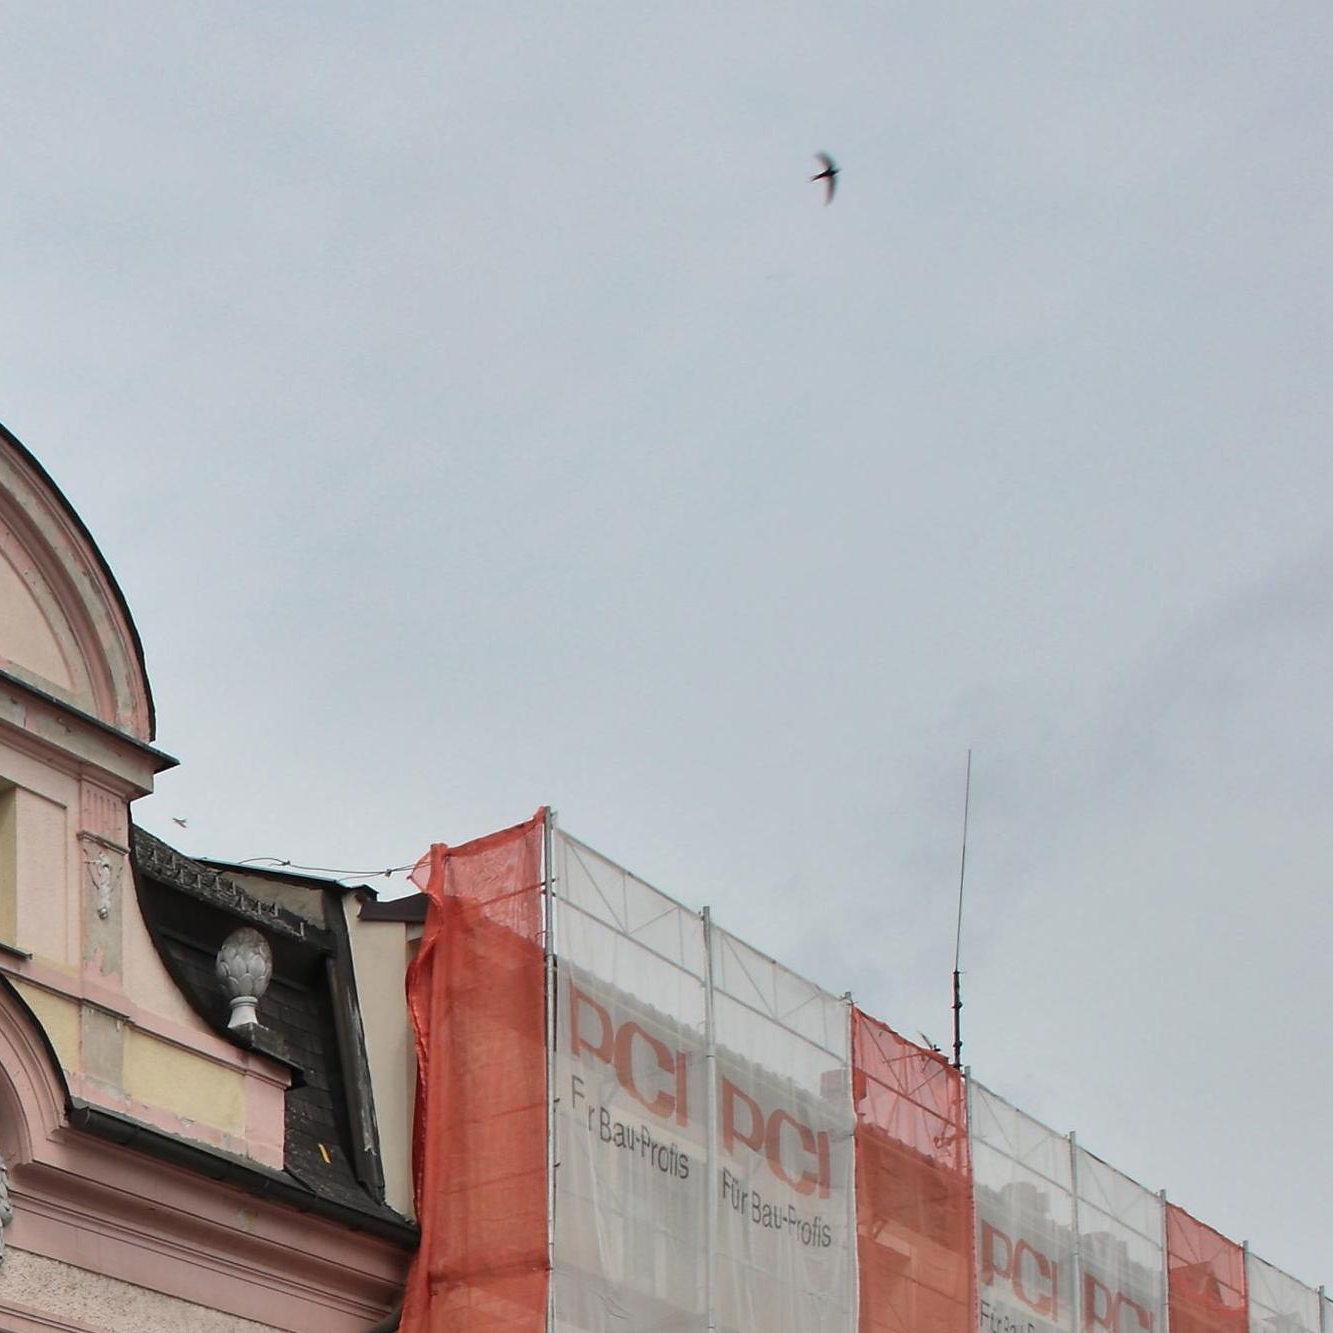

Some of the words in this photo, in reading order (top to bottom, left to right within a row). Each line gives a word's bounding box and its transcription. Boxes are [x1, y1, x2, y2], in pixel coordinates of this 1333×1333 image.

[569, 979, 688, 1127] PCI
[571, 1074, 595, 1131] Fr
[600, 1107, 689, 1179] Bau-Profis
[722, 1076, 831, 1198] PCI
[723, 1168, 748, 1214] Für
[751, 1191, 831, 1248] Bau-Profis
[981, 1219, 1058, 1322] PCI
